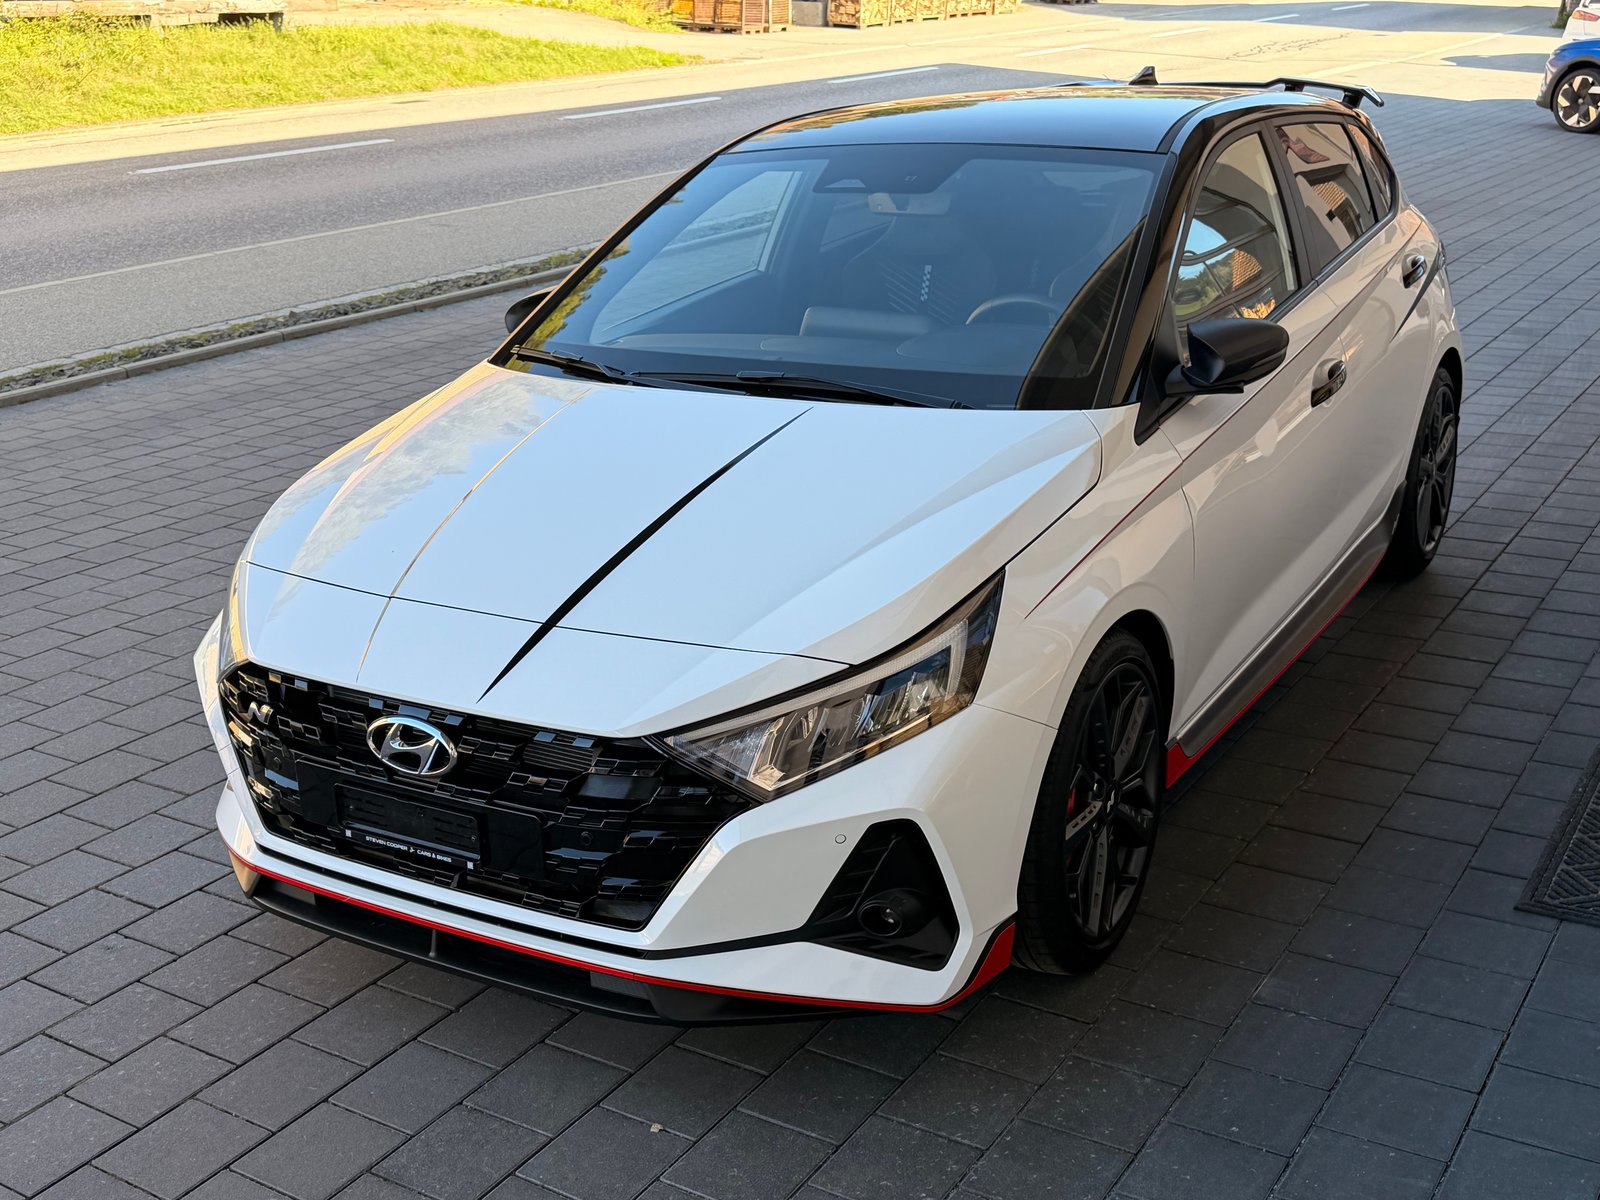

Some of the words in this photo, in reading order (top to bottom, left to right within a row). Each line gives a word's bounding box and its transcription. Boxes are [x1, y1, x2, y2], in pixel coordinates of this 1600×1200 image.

[365, 836, 386, 845] STEVEN
[387, 841, 408, 851] COOPER
[417, 849, 431, 857] CARS
